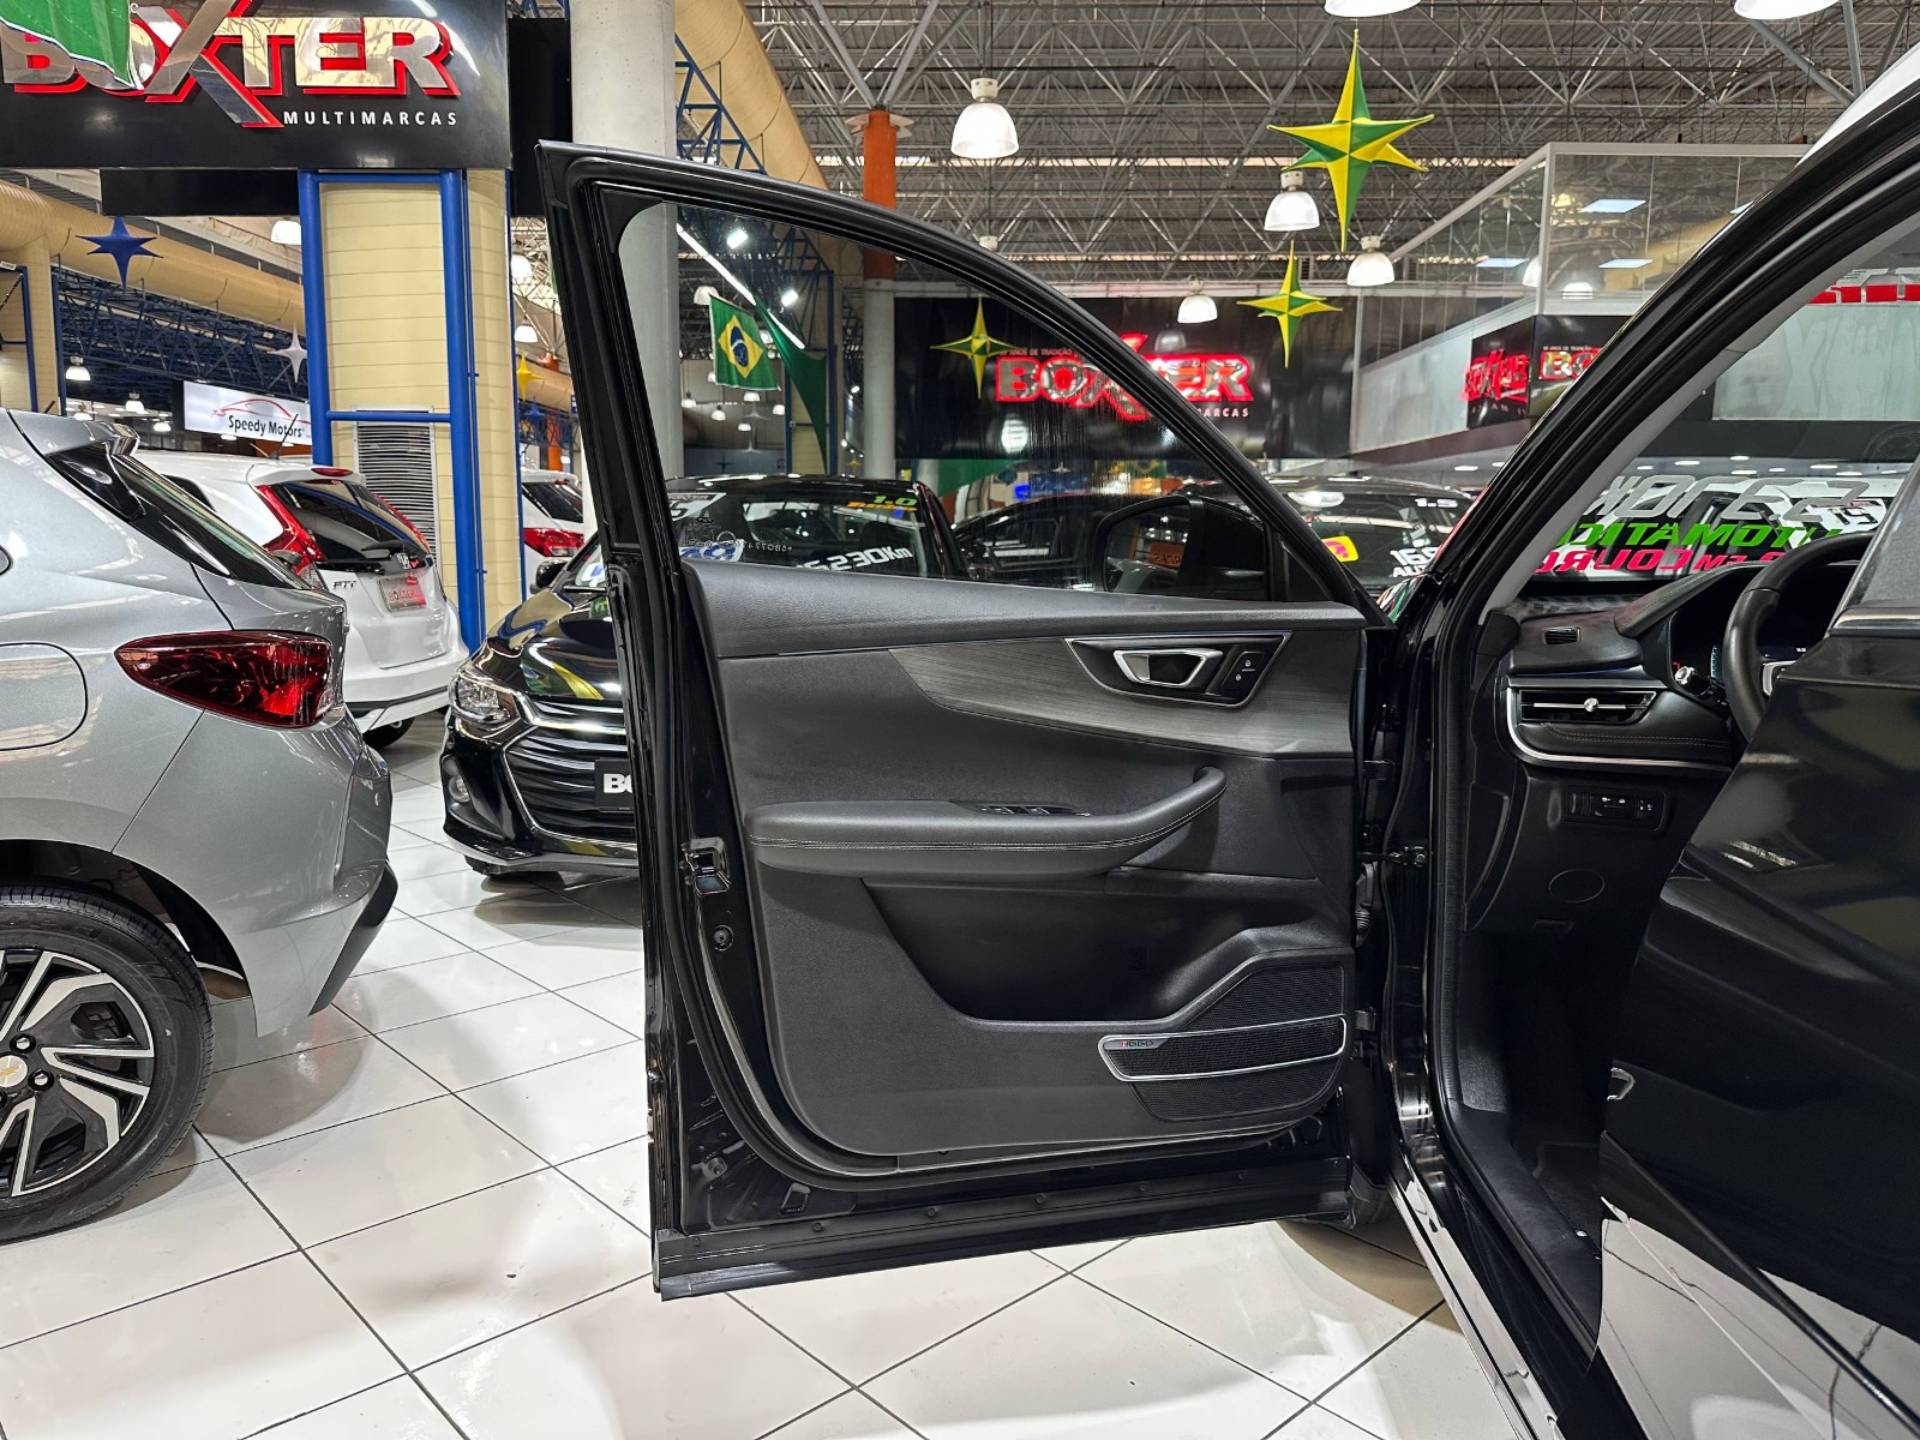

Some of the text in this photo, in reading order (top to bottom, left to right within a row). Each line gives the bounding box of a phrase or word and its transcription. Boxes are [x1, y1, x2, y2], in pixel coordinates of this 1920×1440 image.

[284, 111, 457, 126] MULTIMARCAS
[995, 331, 1254, 421] BOXER
[228, 415, 303, 438] Speedy Motors
[873, 495, 918, 506] 1.0
